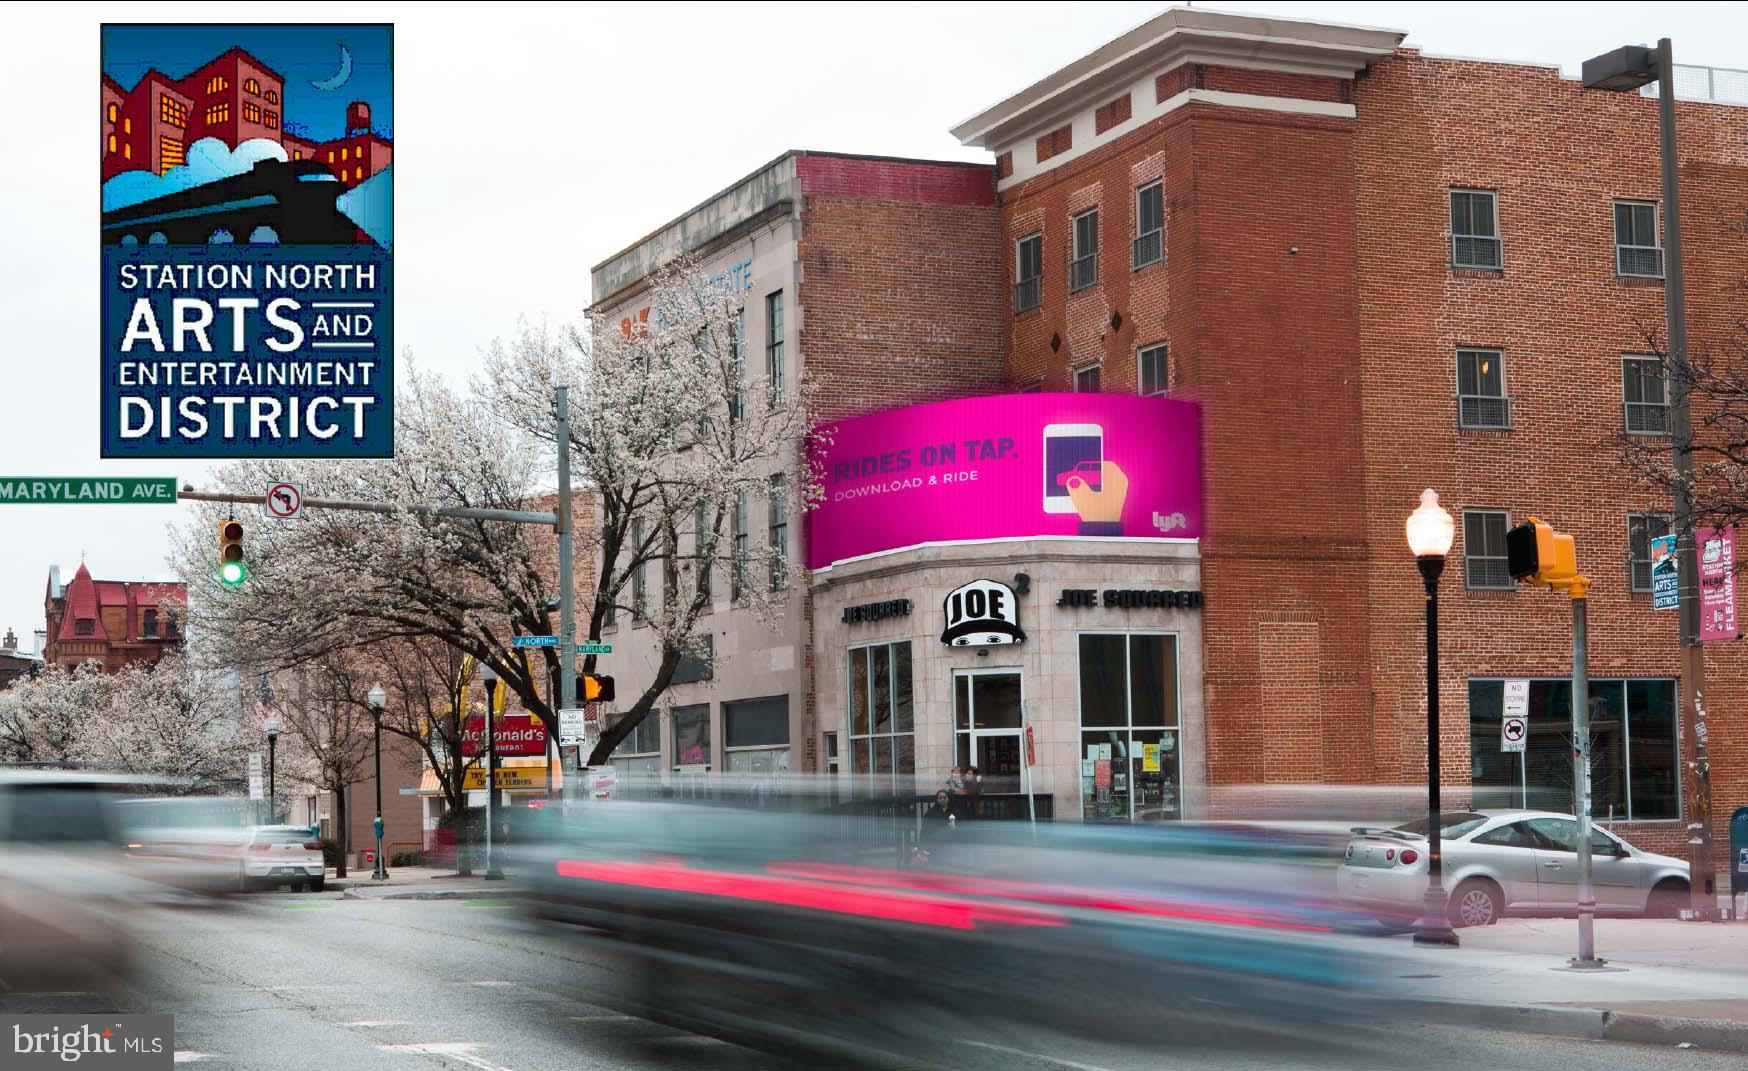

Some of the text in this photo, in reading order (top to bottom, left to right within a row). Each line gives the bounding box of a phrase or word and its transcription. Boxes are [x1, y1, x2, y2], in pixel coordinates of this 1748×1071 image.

[833, 437, 1019, 484] RIDES ON TAP.
[0, 482, 171, 499] MARYLAND AVE.
[834, 470, 979, 502] DOWNLOAD & RIDE
[1654, 579, 1672, 593] ARTS
[949, 588, 1006, 624] JOE
[1056, 589, 1203, 609] JOE SQUARED
[1655, 595, 1678, 608] DISTRICT
[525, 636, 549, 646] NORTH
